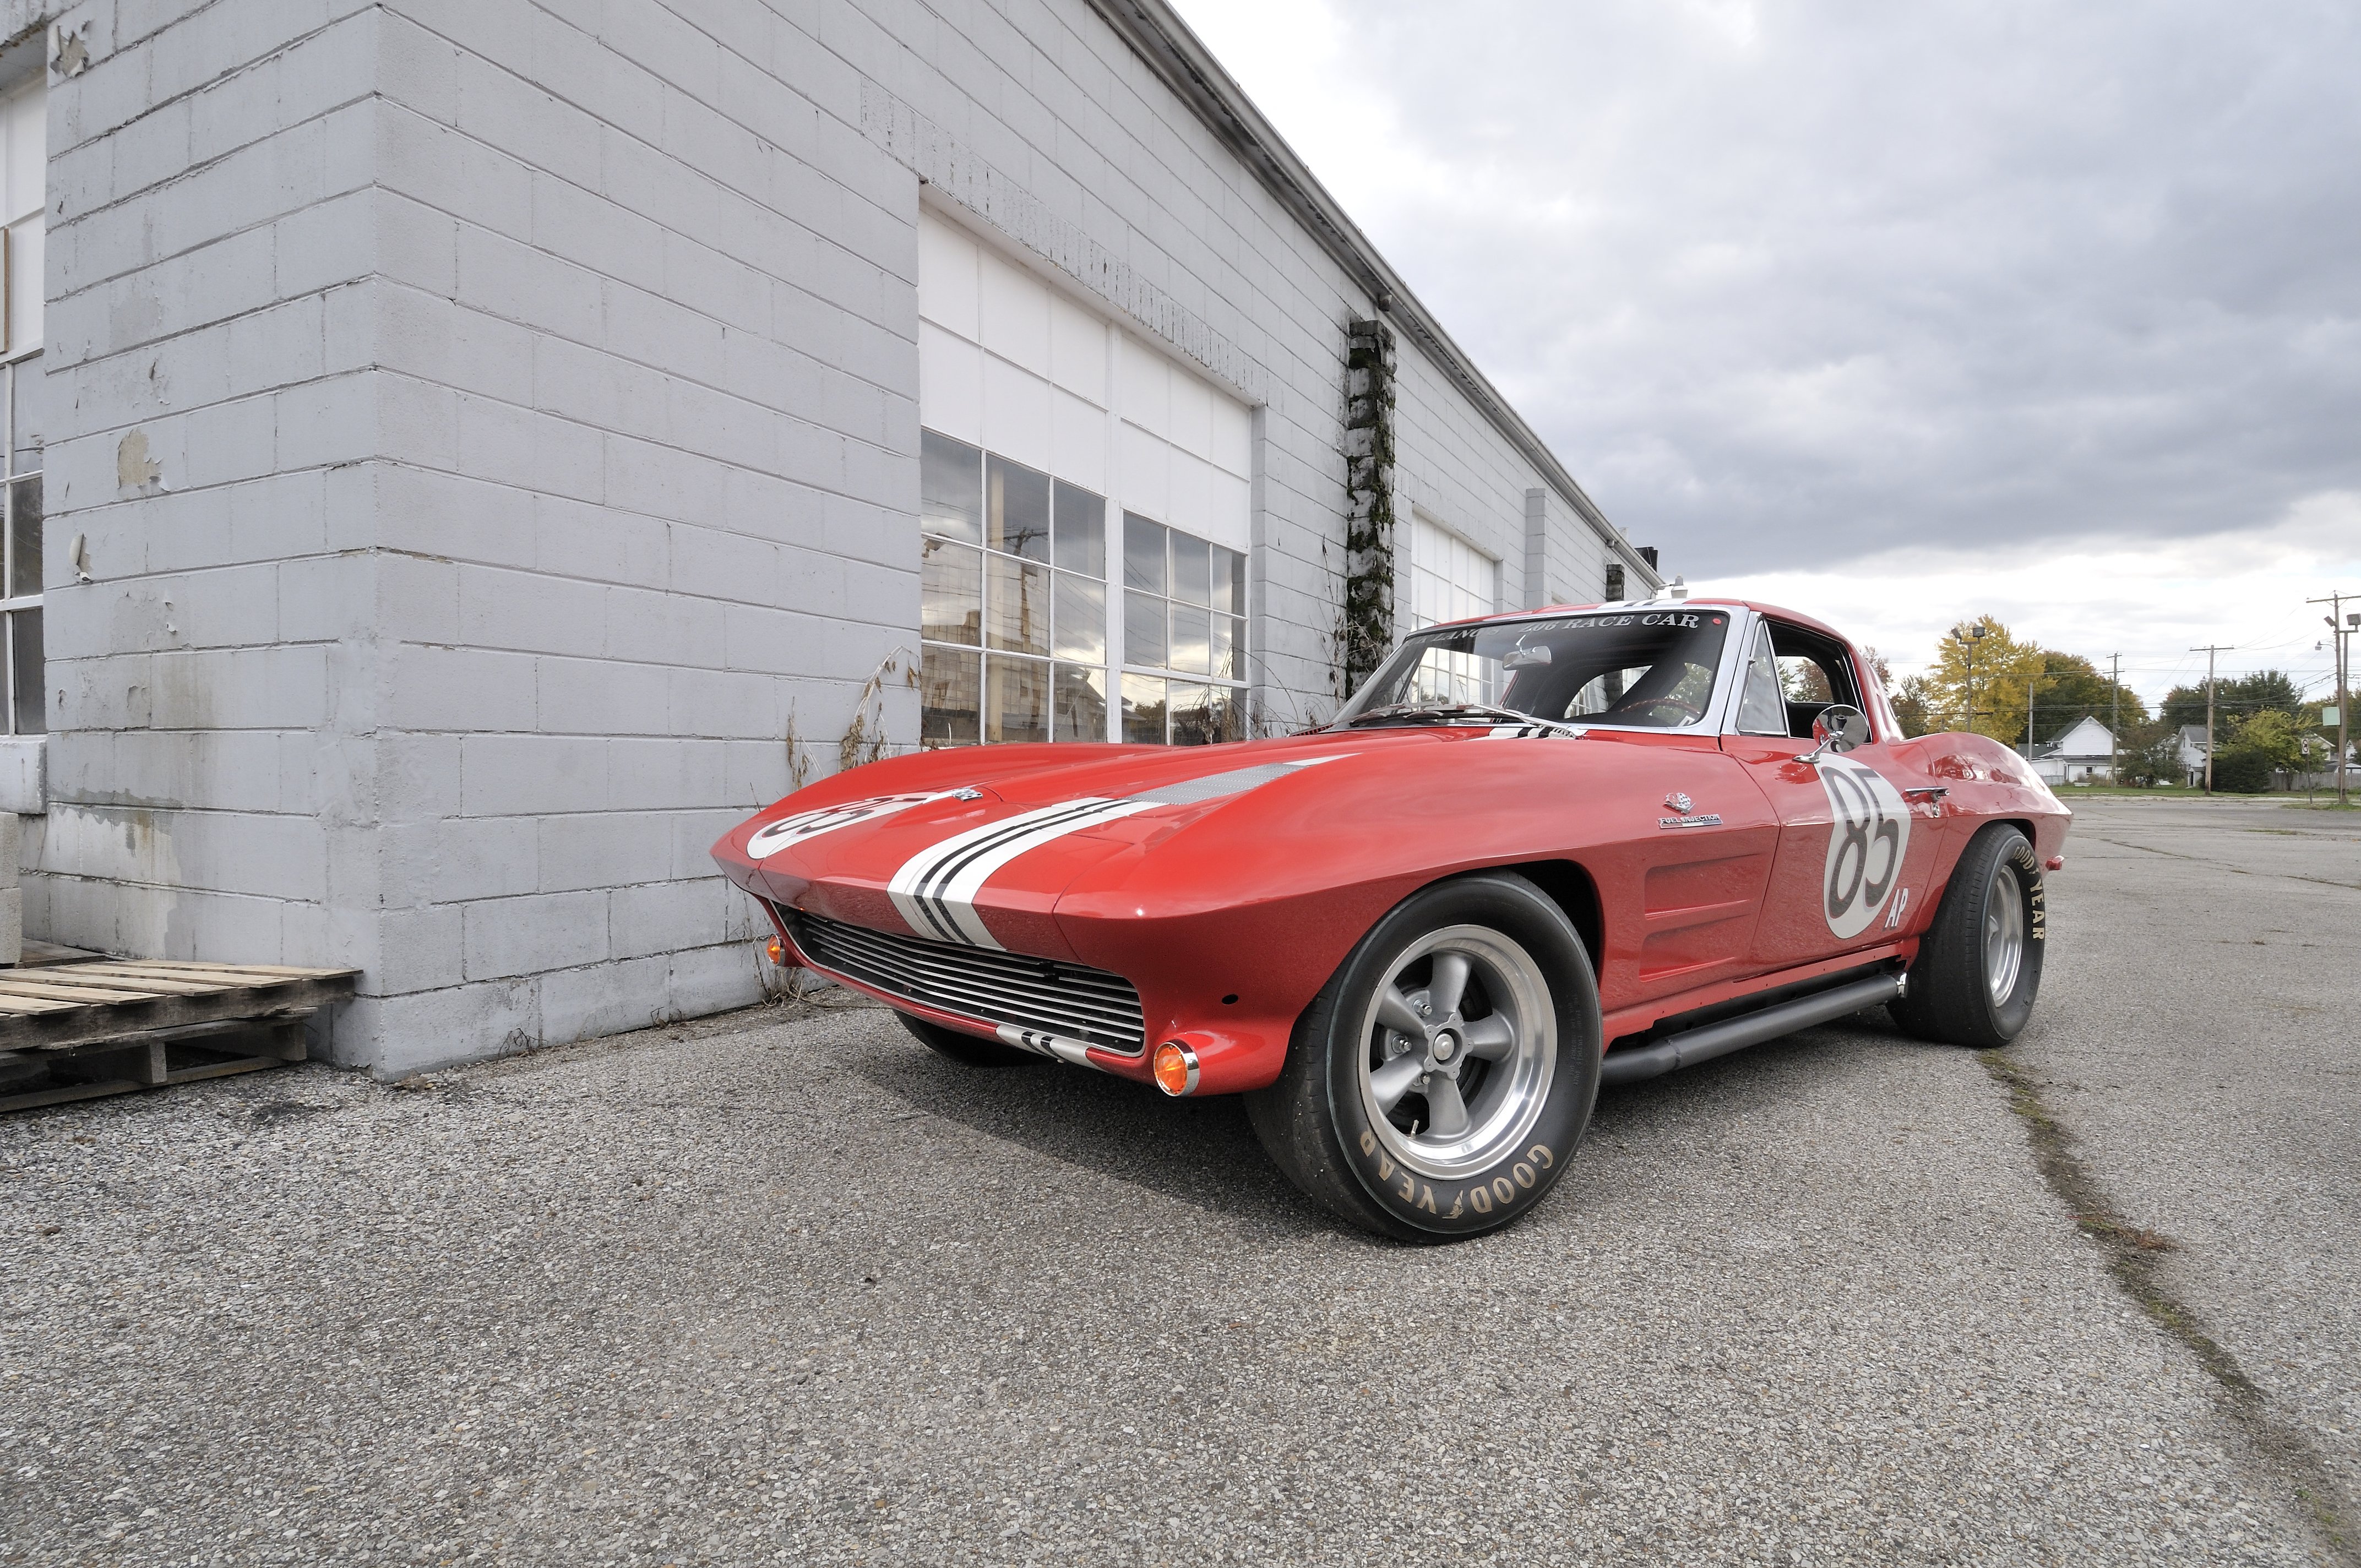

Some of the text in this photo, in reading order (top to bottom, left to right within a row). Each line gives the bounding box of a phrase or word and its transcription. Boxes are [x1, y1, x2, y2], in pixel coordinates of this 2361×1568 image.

[1562, 614, 1635, 629] RACE
[1641, 613, 1699, 629] CAR
[1680, 814, 1721, 823] INJECTION
[1821, 766, 1898, 919] 85
[1884, 888, 1908, 930] AP
